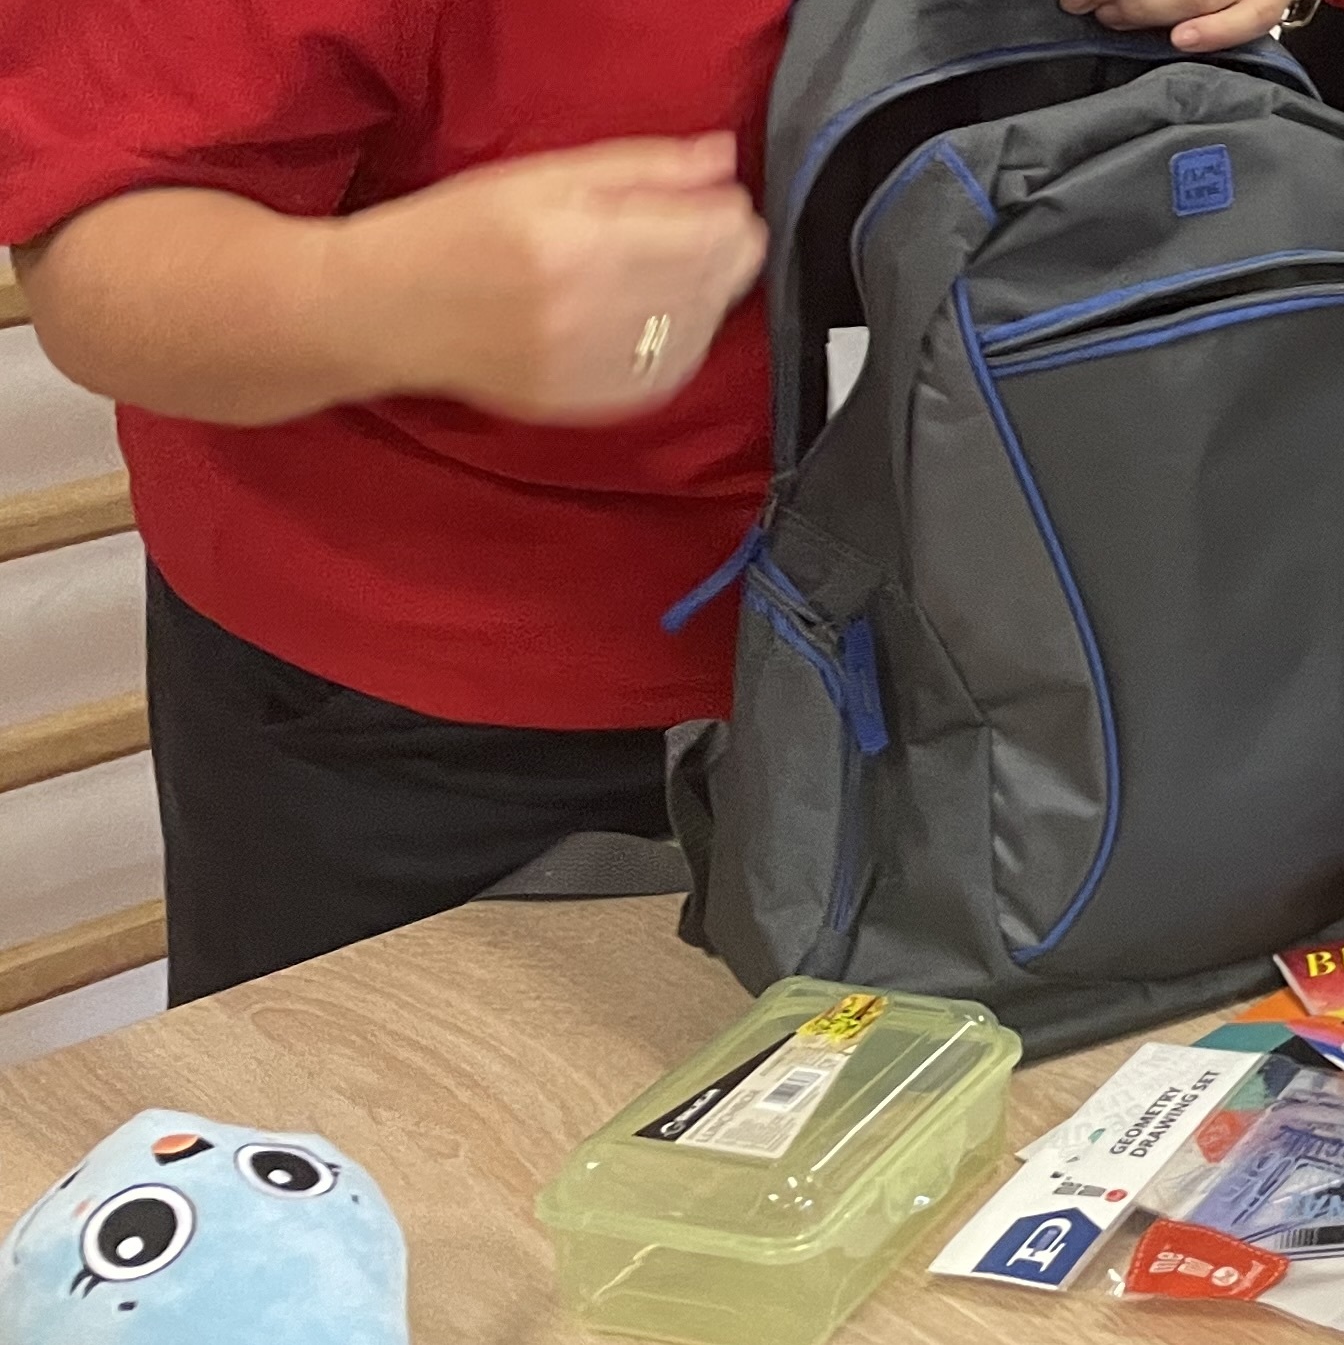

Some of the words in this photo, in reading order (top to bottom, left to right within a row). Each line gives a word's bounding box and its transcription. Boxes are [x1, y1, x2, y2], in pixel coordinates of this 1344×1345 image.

[1109, 1085, 1183, 1156] GEOMETRY
[1130, 1091, 1199, 1159] DRAWING
[1191, 1069, 1222, 1098] SET
